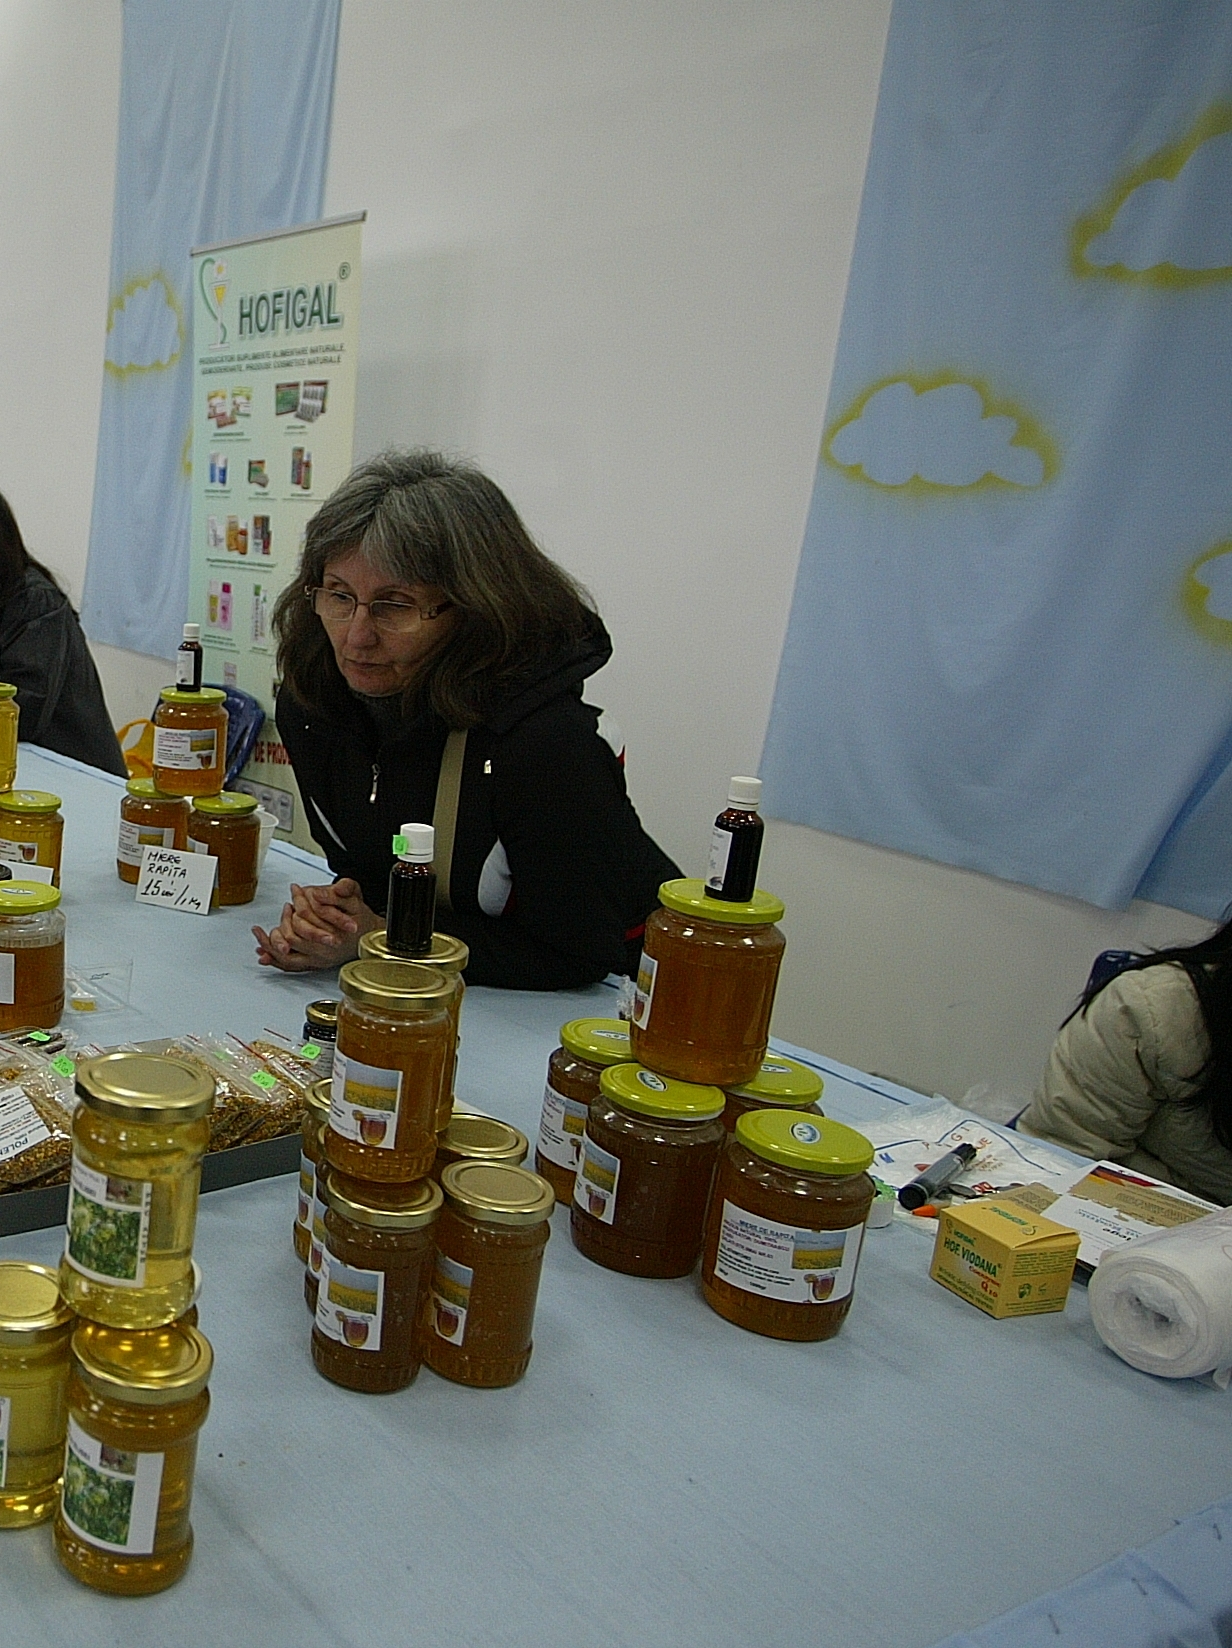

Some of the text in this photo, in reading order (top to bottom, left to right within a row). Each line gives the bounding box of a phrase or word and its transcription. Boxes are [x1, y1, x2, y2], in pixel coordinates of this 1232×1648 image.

[239, 283, 341, 335] HOFIGAL
[147, 863, 187, 878] RAPITA
[140, 878, 162, 896] 15
[962, 1246, 998, 1278] VIODANA
